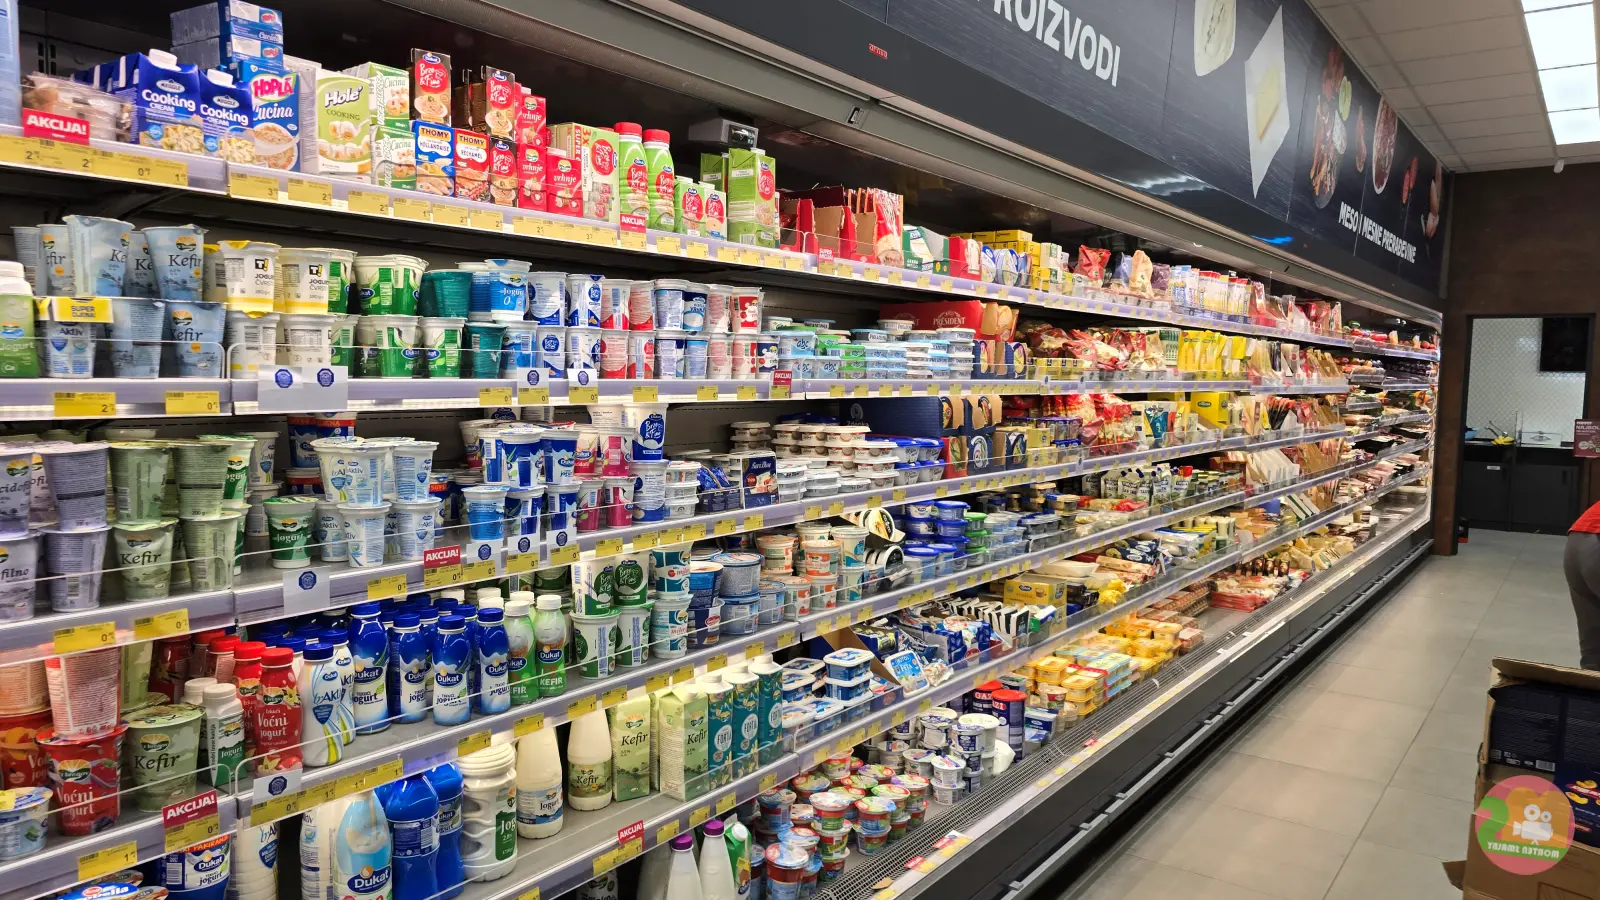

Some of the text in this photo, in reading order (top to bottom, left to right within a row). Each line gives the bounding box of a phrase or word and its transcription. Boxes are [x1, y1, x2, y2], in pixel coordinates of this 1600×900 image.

[384, 76, 406, 88] Cucina
[141, 89, 197, 112] Cooking
[150, 102, 176, 113] CREAM
[200, 104, 249, 126] Cooking
[326, 108, 361, 121] COOKING
[26, 114, 87, 135] AKCIJA!
[206, 116, 230, 127] CREAM
[420, 127, 449, 139] THOMY
[459, 135, 485, 147] THOMY
[522, 163, 544, 173] vrhnje
[553, 173, 577, 185] vrhnje
[621, 216, 645, 227] AKCIJA!
[1338, 201, 1359, 233] MESO
[1362, 215, 1383, 246] MESNE
[169, 254, 202, 270] Kefir
[503, 288, 524, 297] Jogur
[71, 305, 95, 313] SUPER
[171, 327, 203, 341] Kefir
[227, 472, 247, 484] ogurt
[276, 533, 304, 544] Jogurt
[121, 551, 162, 567] Kefir
[425, 548, 459, 562] AKCIJA!
[540, 651, 560, 660] Dukat
[437, 674, 460, 683] Dukat
[539, 677, 563, 686] KEFIR
[353, 693, 379, 706] ogurt
[975, 691, 993, 700] GAZ
[993, 700, 1006, 710] AZI
[258, 713, 289, 727] Voćni
[260, 727, 287, 741] jogurt
[621, 732, 648, 747] Kefir
[687, 728, 708, 745] Kefir
[221, 745, 243, 759] Jogurt
[135, 754, 180, 770] Kefir
[576, 775, 599, 786] Kefir
[56, 786, 94, 804] Voćni
[166, 794, 215, 820] AKCIJA!
[540, 799, 560, 810] Jogurt
[439, 811, 453, 820] ukat
[619, 822, 643, 839] AKCIJA!
[198, 856, 224, 870] Dukat
[199, 871, 223, 886] jogurt
[354, 869, 389, 889] Dukat
